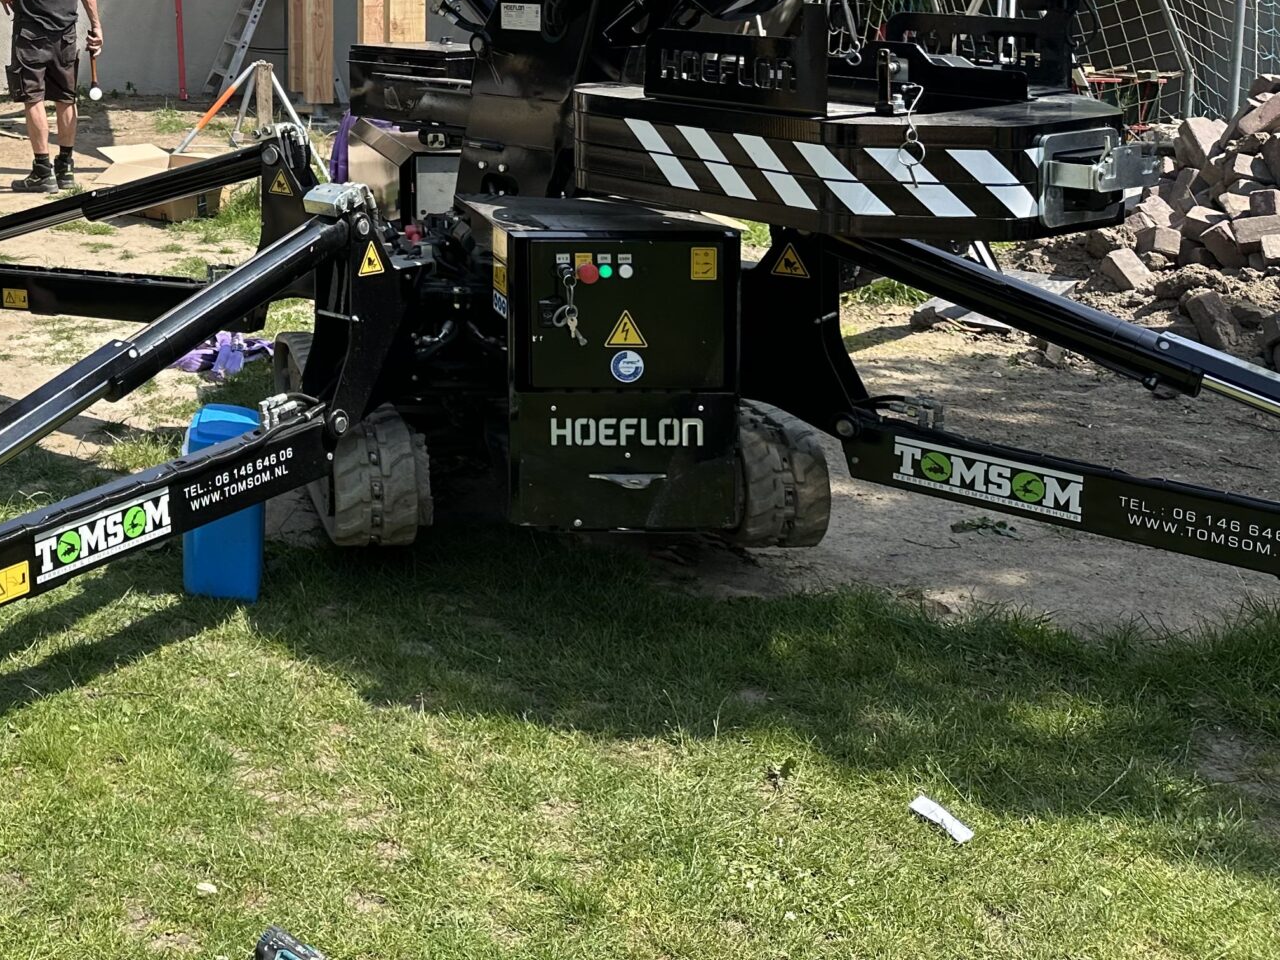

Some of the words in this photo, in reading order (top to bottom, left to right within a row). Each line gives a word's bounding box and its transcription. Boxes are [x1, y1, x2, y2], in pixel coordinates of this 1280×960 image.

[550, 418, 704, 446] HOEFLON
[190, 464, 289, 511] WWW.TOMSOM.NL
[215, 472, 229, 486] 06
[233, 463, 253, 479] 146
[256, 453, 277, 470] 646
[279, 447, 293, 461] 06
[894, 443, 1084, 514] TOMSOM
[34, 493, 172, 574] TOMSOM
[1173, 508, 1196, 523] 06
[1206, 515, 1240, 532] 146
